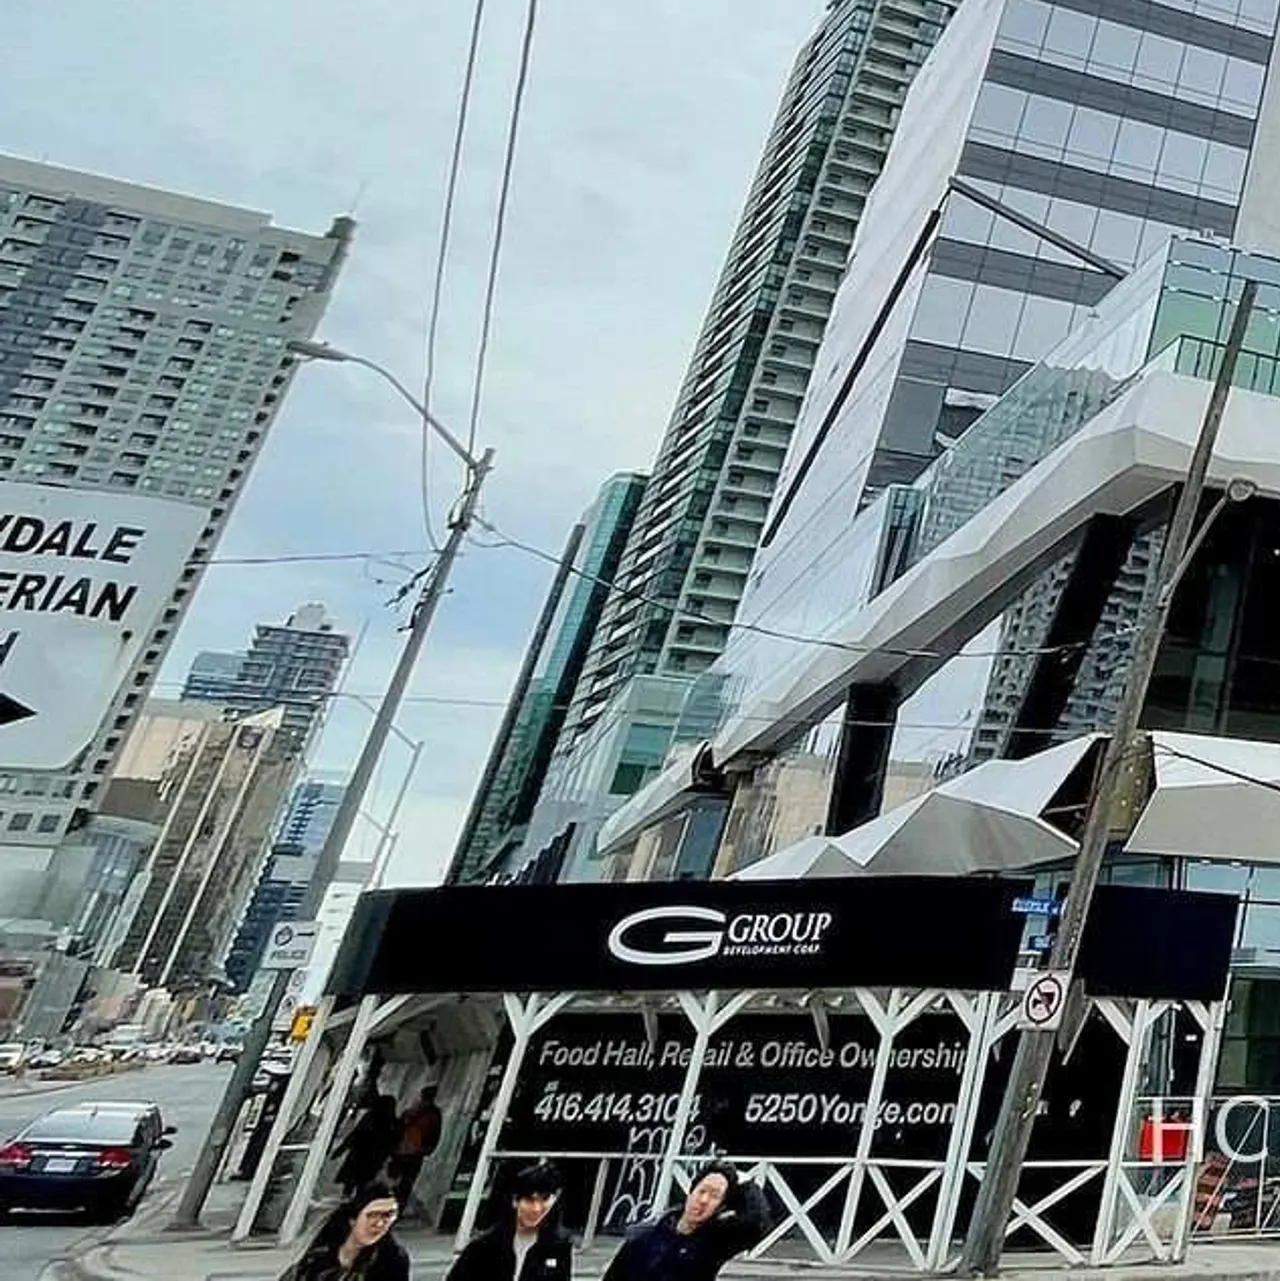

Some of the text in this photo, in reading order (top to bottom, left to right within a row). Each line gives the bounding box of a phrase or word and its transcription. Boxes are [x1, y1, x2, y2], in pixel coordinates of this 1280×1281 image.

[0, 514, 147, 564] DALE
[728, 913, 832, 943] GROUP
[539, 1040, 602, 1066] Food
[602, 1040, 655, 1070] Hall,
[660, 1040, 734, 1066] Reail
[735, 1041, 755, 1067] &
[760, 1041, 835, 1068] Office
